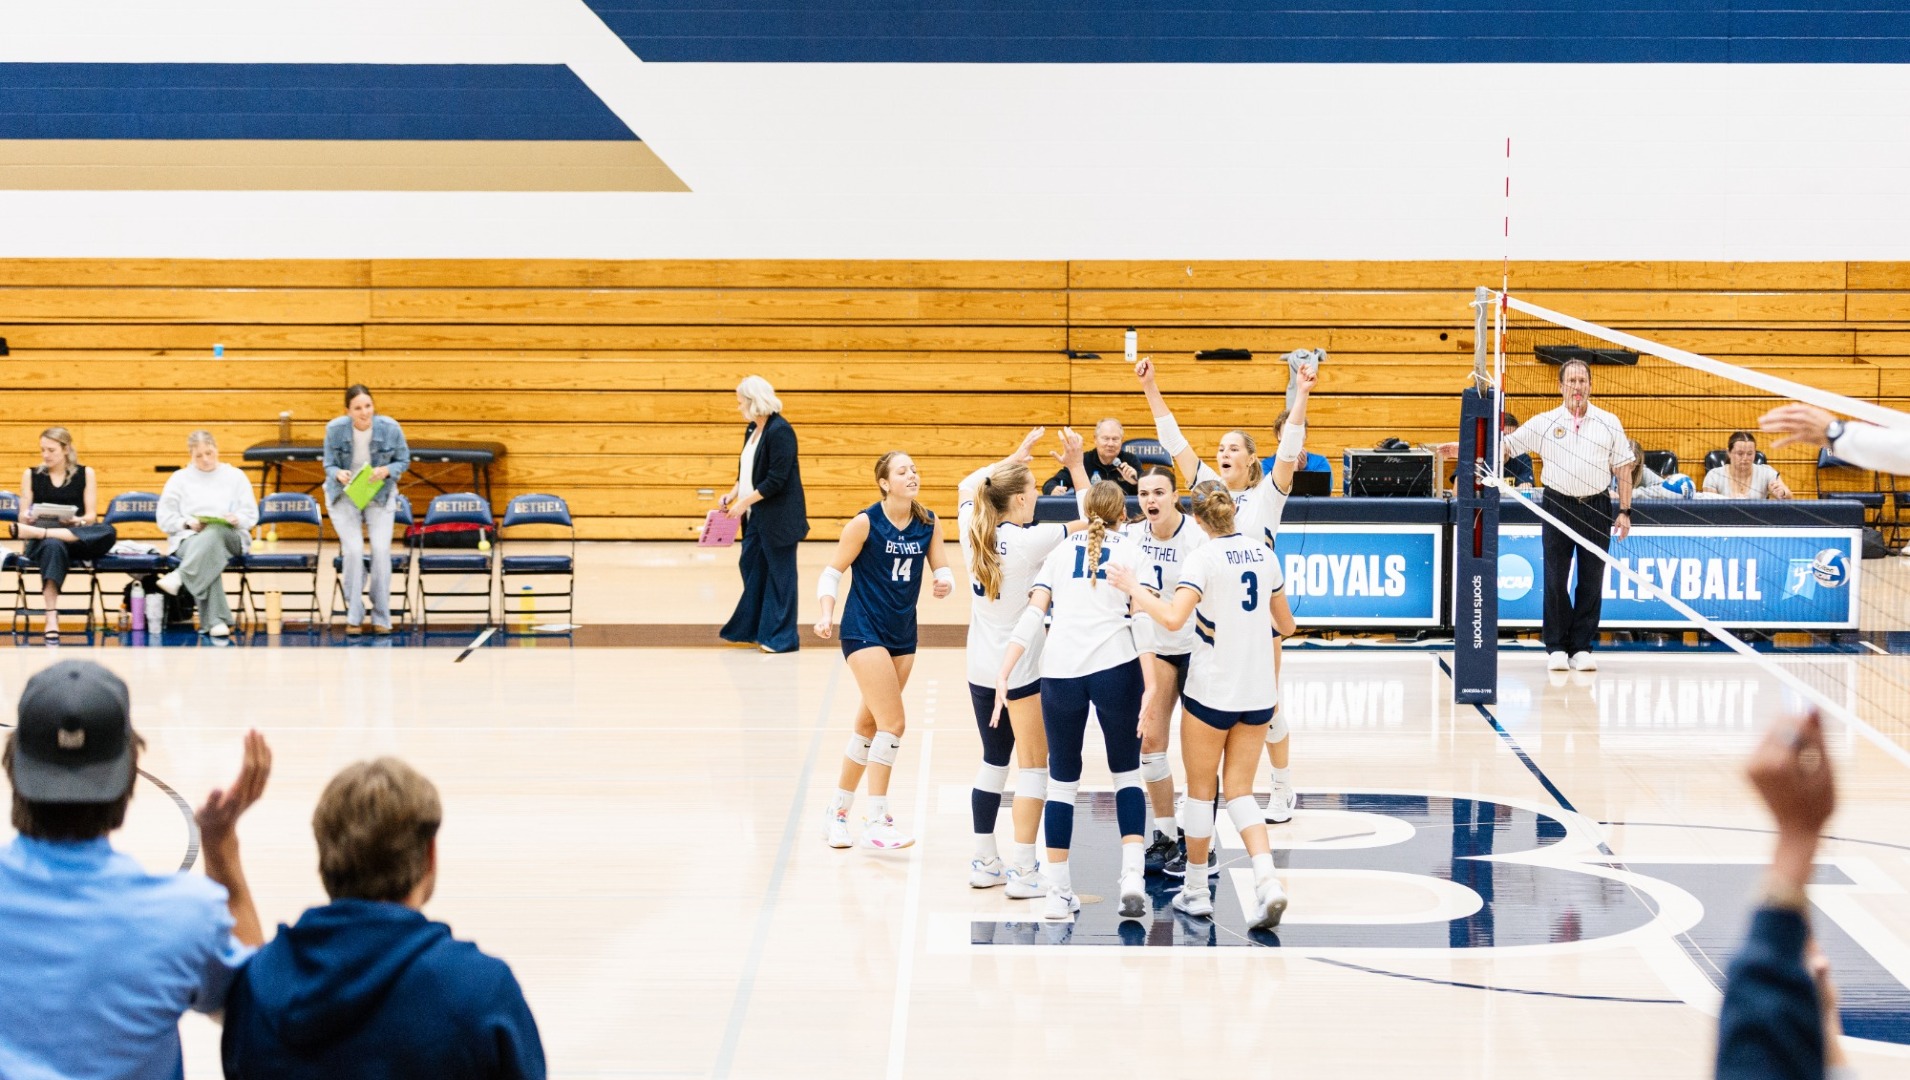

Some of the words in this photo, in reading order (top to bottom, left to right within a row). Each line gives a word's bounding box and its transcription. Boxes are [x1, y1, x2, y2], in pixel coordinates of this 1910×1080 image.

[1125, 445, 1165, 455] BETHEL
[115, 501, 158, 512] BETHE
[264, 501, 312, 512] BETHEL
[435, 501, 482, 512] BETHEL
[514, 502, 562, 513] BETHEL
[885, 540, 923, 554] BETHEL
[1226, 549, 1264, 565] ROYALS
[892, 558, 913, 582] 14
[1072, 545, 1111, 580] 12
[1285, 554, 1406, 597] ROYALS
[1566, 558, 1762, 601] LLEYBALL
[1241, 571, 1258, 612] 3
[1472, 575, 1483, 608] sports
[1472, 608, 1483, 649] imports
